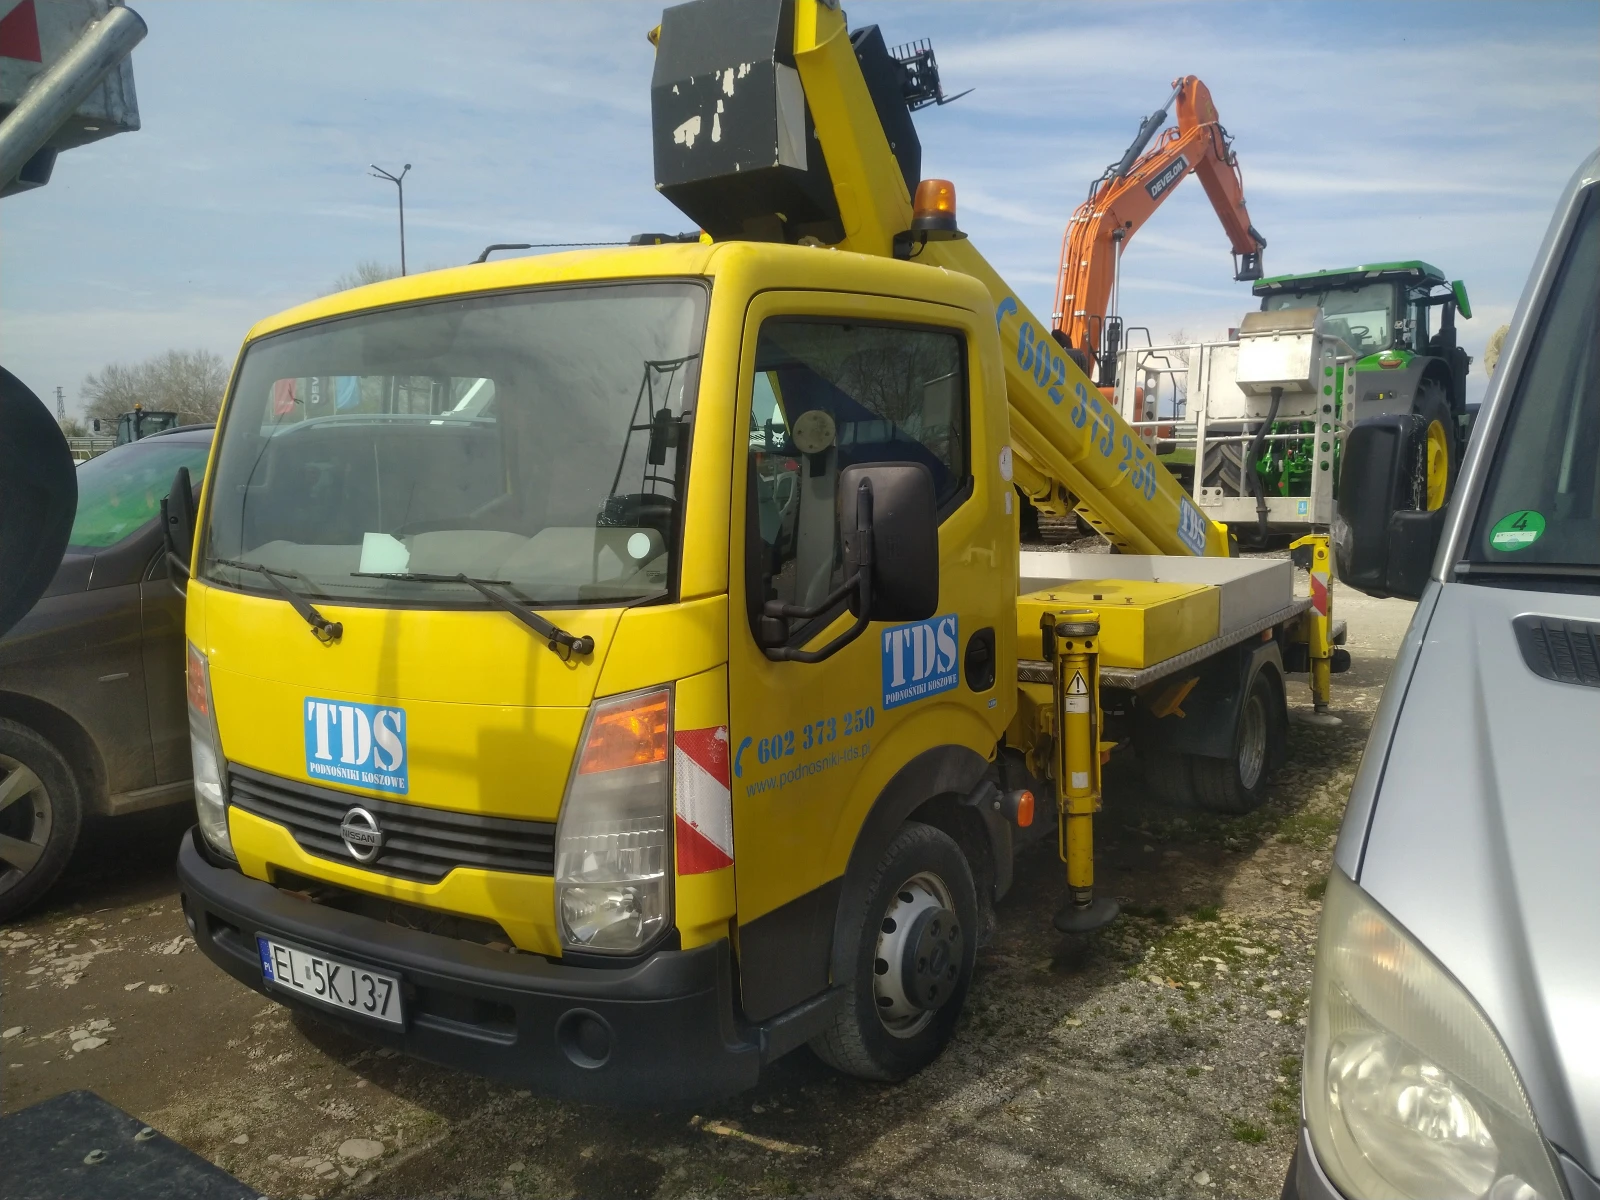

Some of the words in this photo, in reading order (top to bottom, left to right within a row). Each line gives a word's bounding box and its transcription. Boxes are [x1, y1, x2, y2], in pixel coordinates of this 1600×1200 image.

[1151, 161, 1184, 197] DEVELON
[1017, 322, 1066, 405] 602
[1071, 382, 1115, 458] 373
[1118, 434, 1157, 501] 250
[1181, 497, 1206, 549] TDS
[1511, 512, 1529, 531] 4
[885, 617, 957, 688] TDS
[885, 683, 927, 705] PODNOŚNIKI
[928, 674, 957, 691] KOSZOWE
[307, 701, 404, 772] TDS
[757, 730, 796, 765] 602
[802, 717, 837, 750] 373
[843, 706, 875, 736] 250
[309, 763, 360, 781] PODNOŚNIKI
[361, 771, 405, 789] KOSZOWE
[746, 740, 871, 798] www.podnosniki-tds.pl
[342, 828, 375, 843] NISSAN
[263, 961, 273, 973] PL
[273, 945, 304, 989] EL
[312, 958, 393, 1016] 5KJ37
